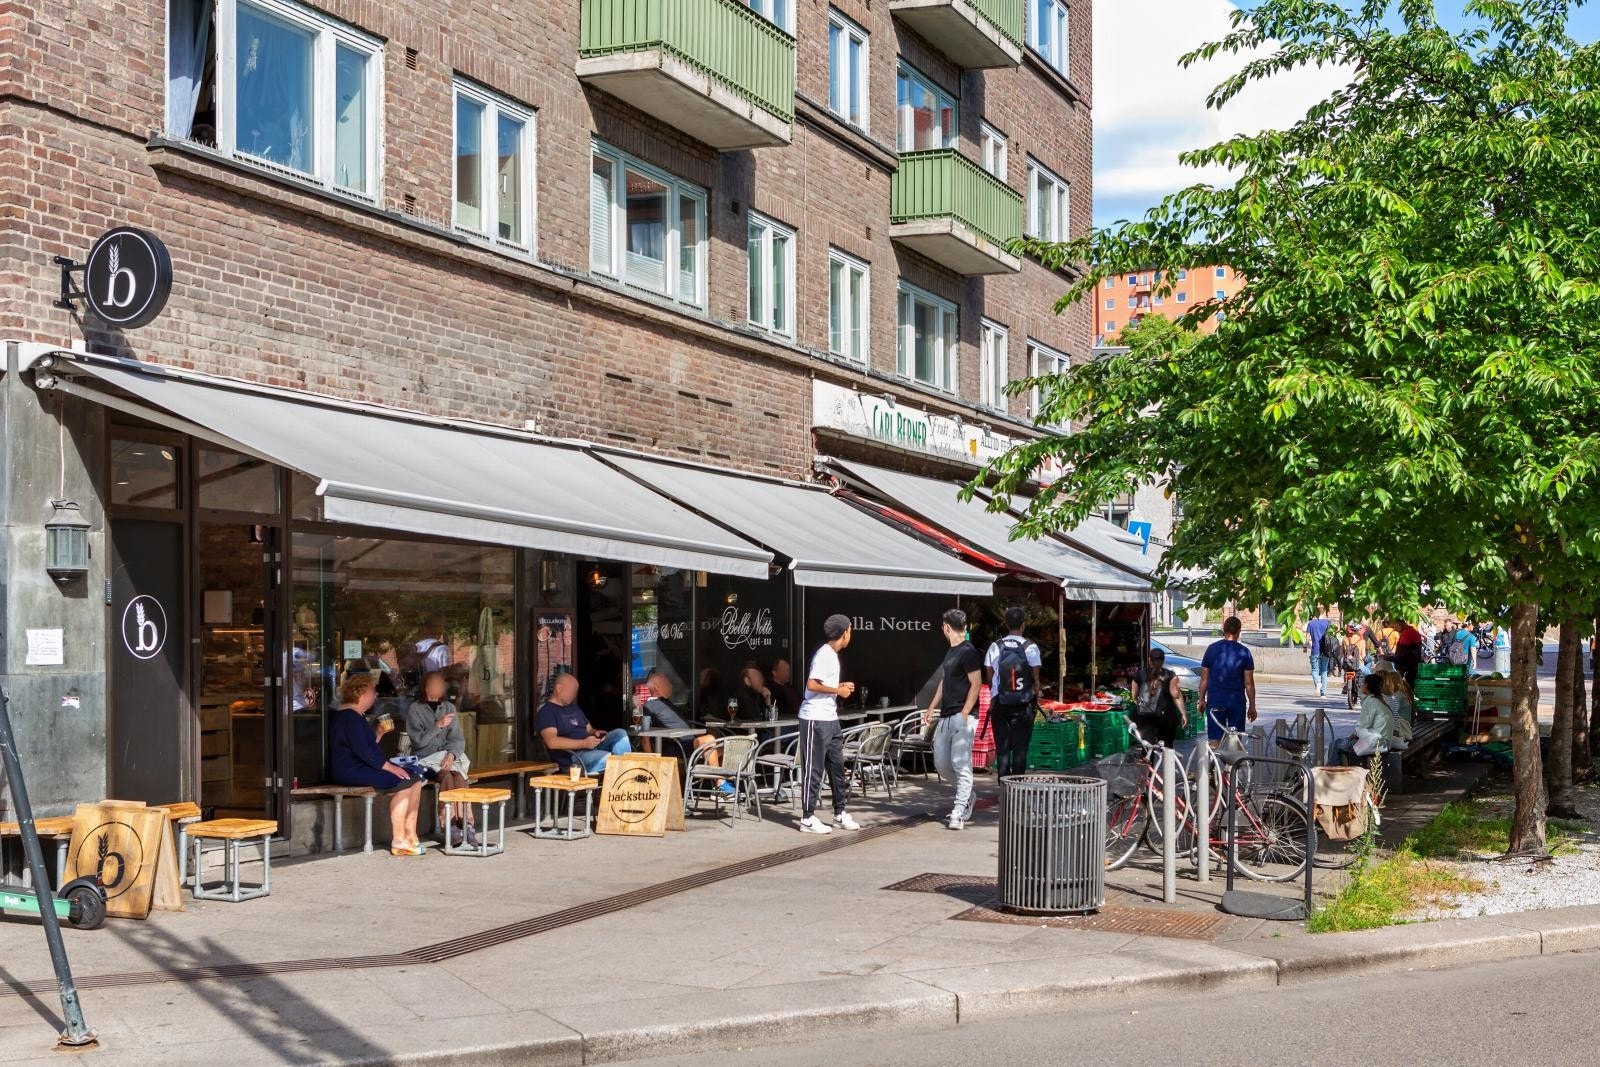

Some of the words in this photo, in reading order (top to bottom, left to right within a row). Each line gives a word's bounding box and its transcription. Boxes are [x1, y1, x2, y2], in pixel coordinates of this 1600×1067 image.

[720, 606, 750, 636] Bella
[750, 608, 773, 636] Notte
[852, 616, 874, 631] lla
[880, 617, 931, 631] Notte
[608, 789, 661, 803] backstube
